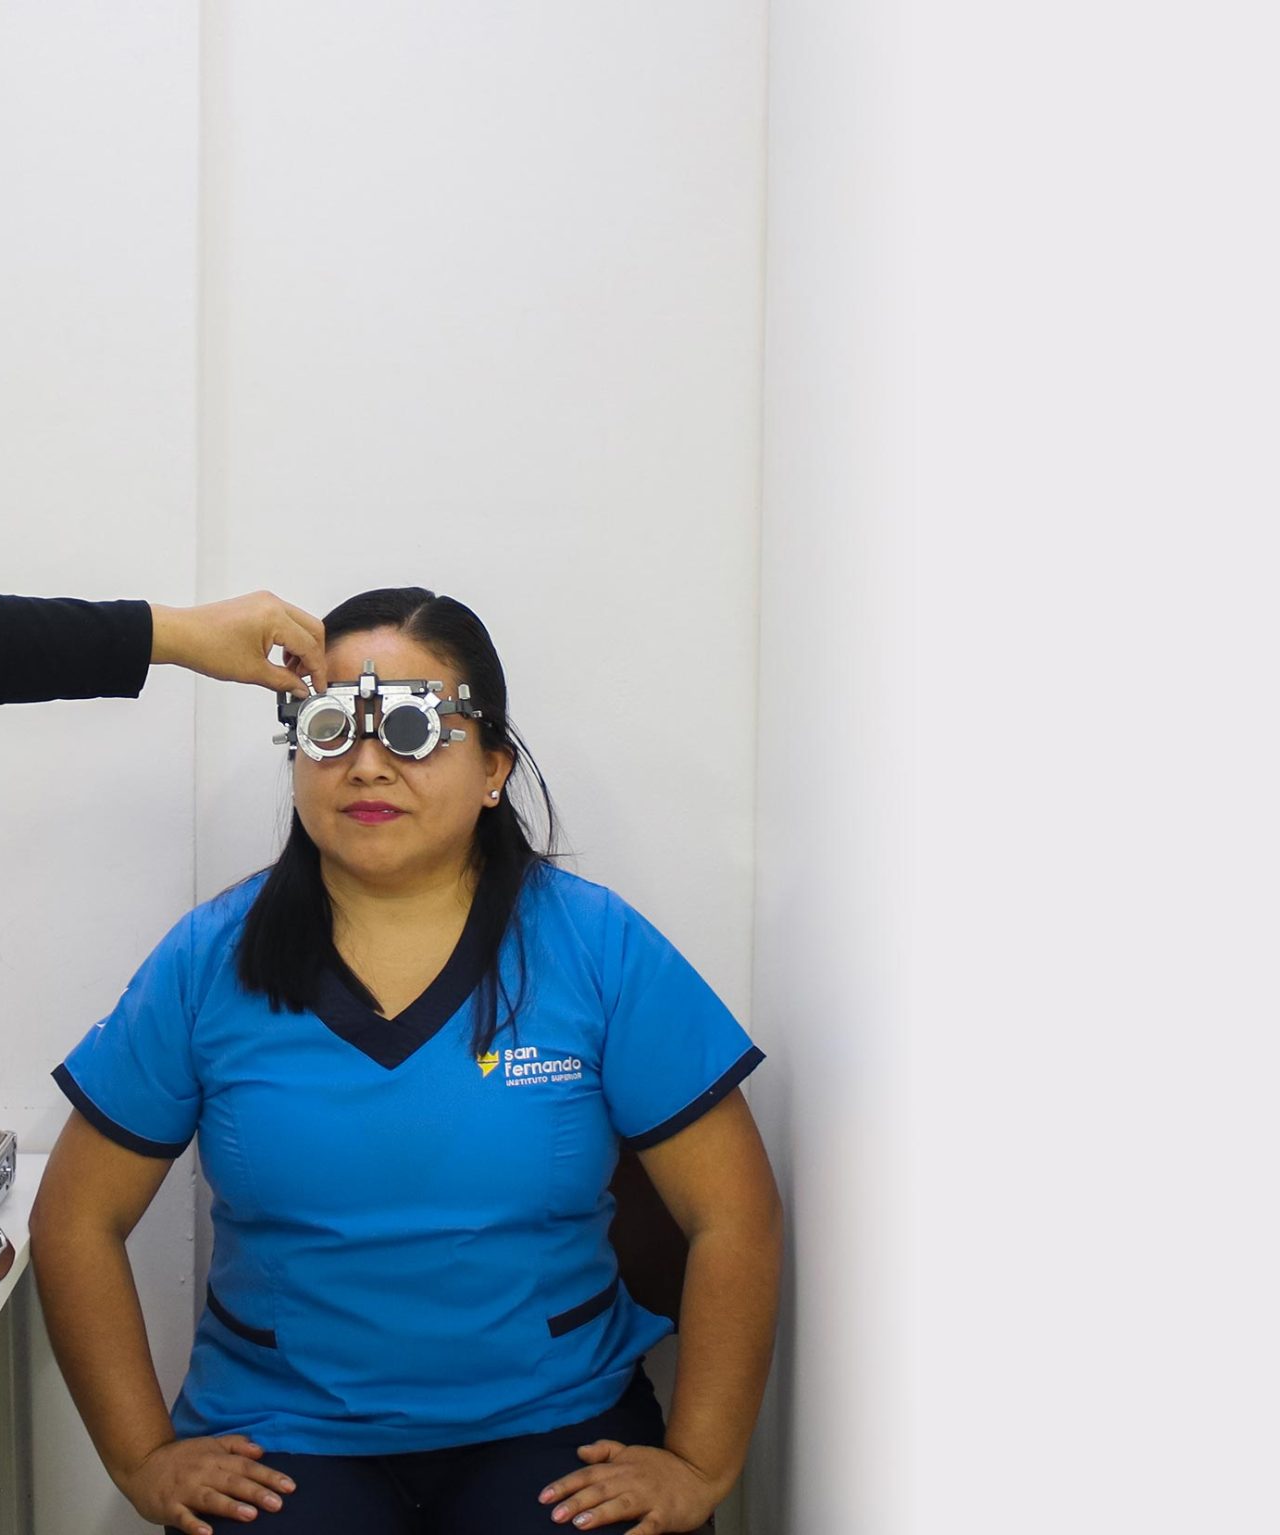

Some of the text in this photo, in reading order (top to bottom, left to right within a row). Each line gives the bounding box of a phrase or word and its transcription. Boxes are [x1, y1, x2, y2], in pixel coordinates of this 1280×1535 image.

[504, 1046, 537, 1061] san
[506, 1072, 582, 1086] INSTITUTO SUPERIOR
